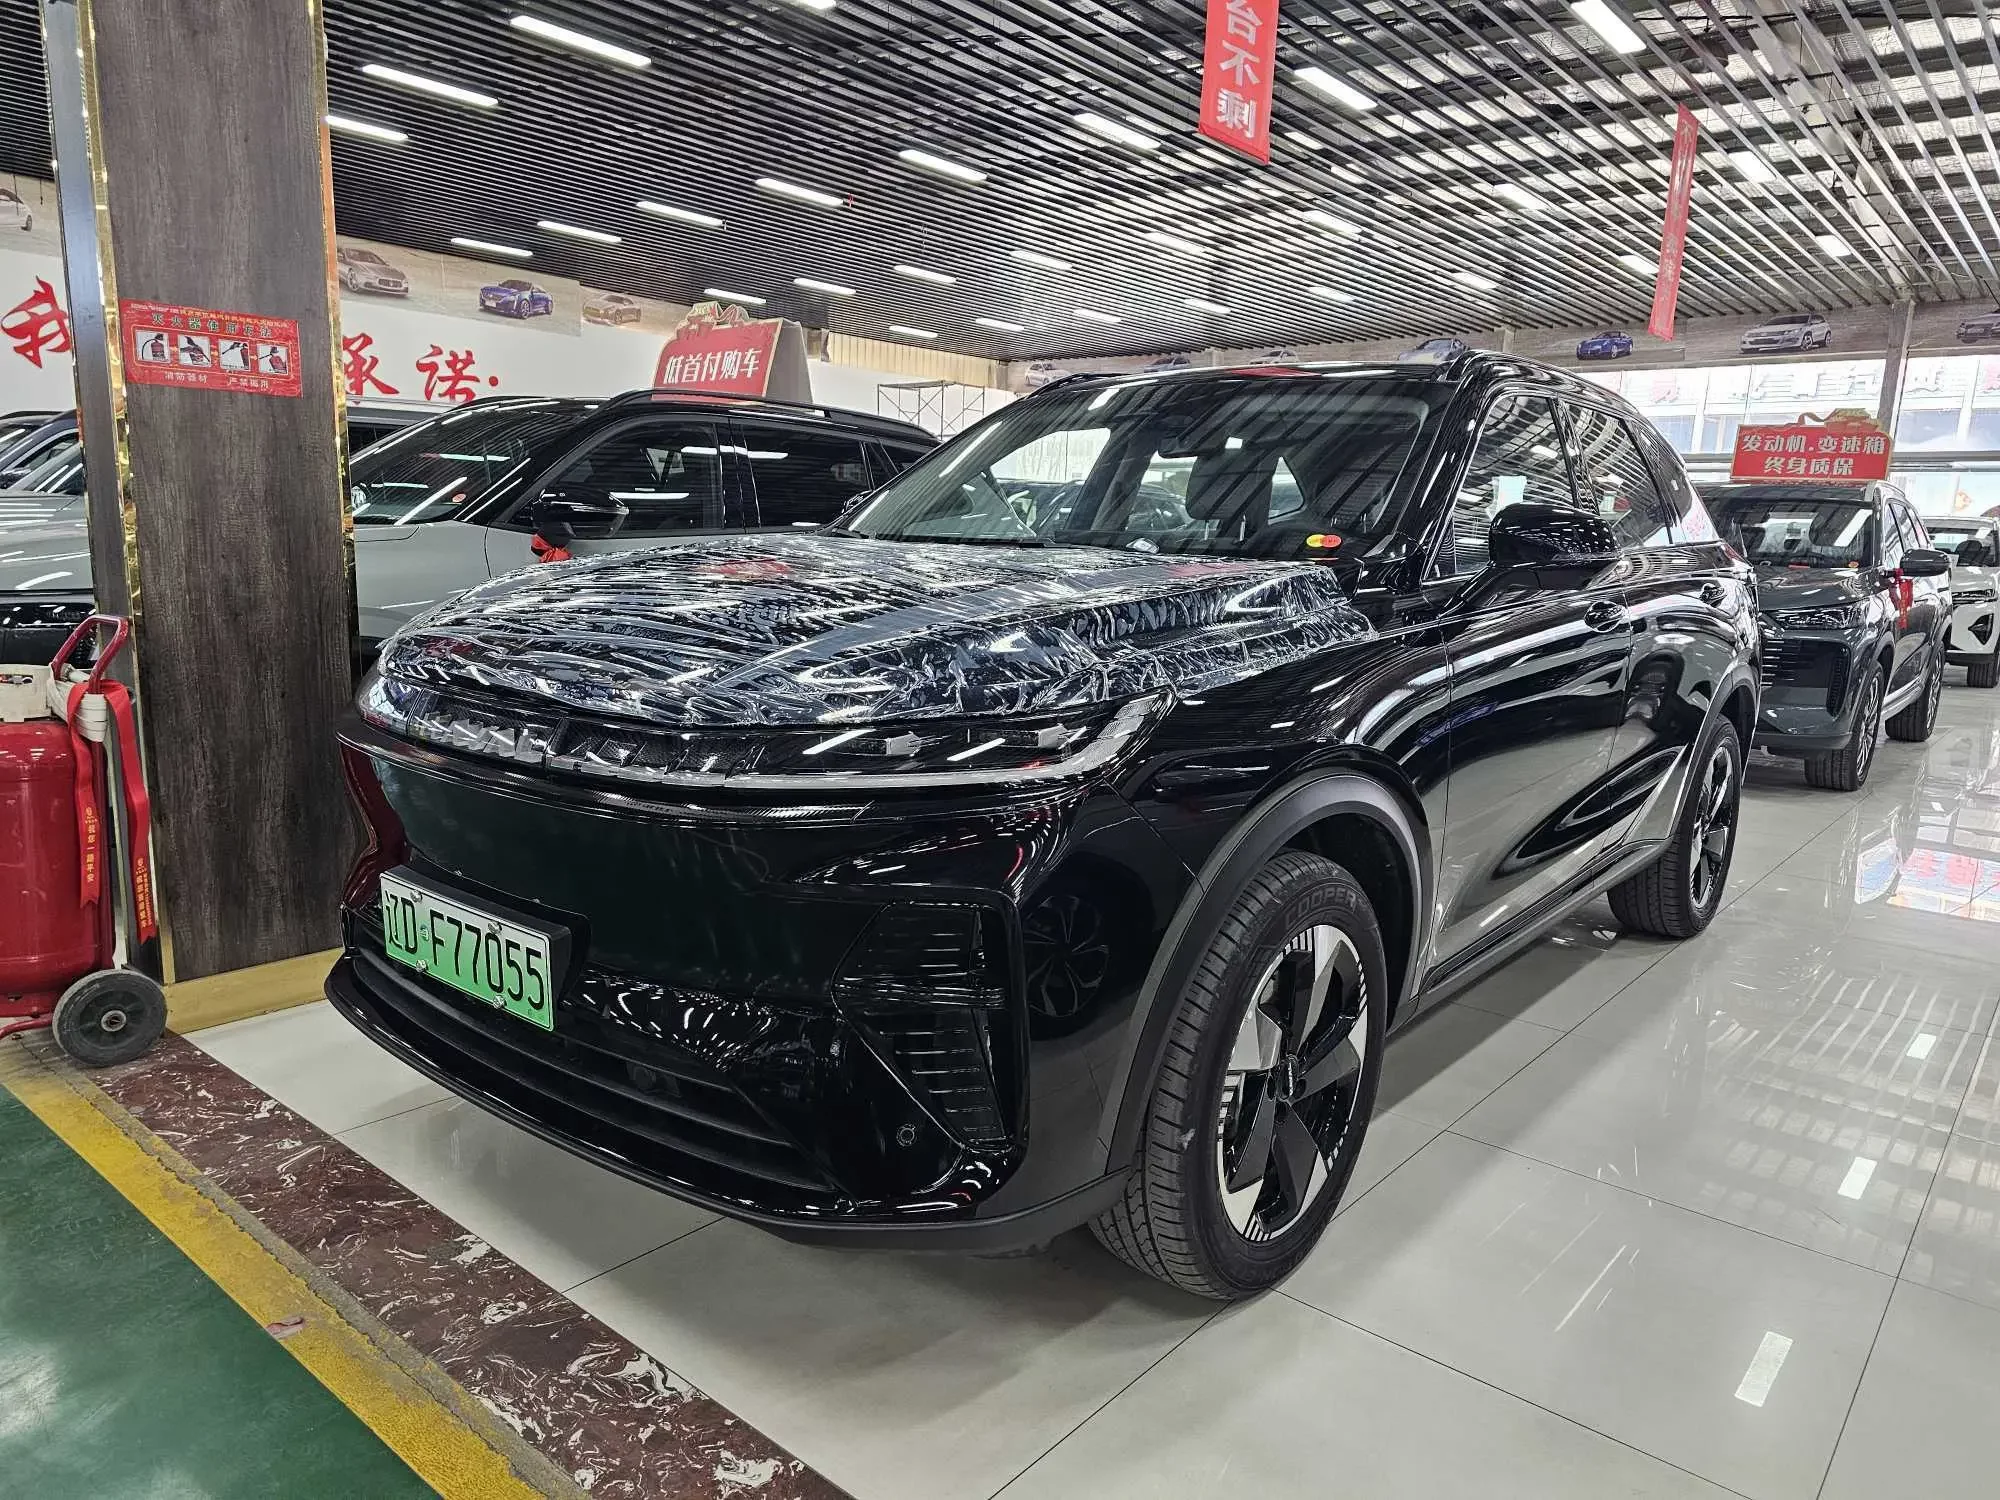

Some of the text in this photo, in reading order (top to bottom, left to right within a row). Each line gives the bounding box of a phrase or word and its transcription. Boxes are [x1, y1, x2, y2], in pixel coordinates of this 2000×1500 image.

[663, 348, 761, 385] 低首付购车
[1763, 456, 1855, 475] 终身质保
